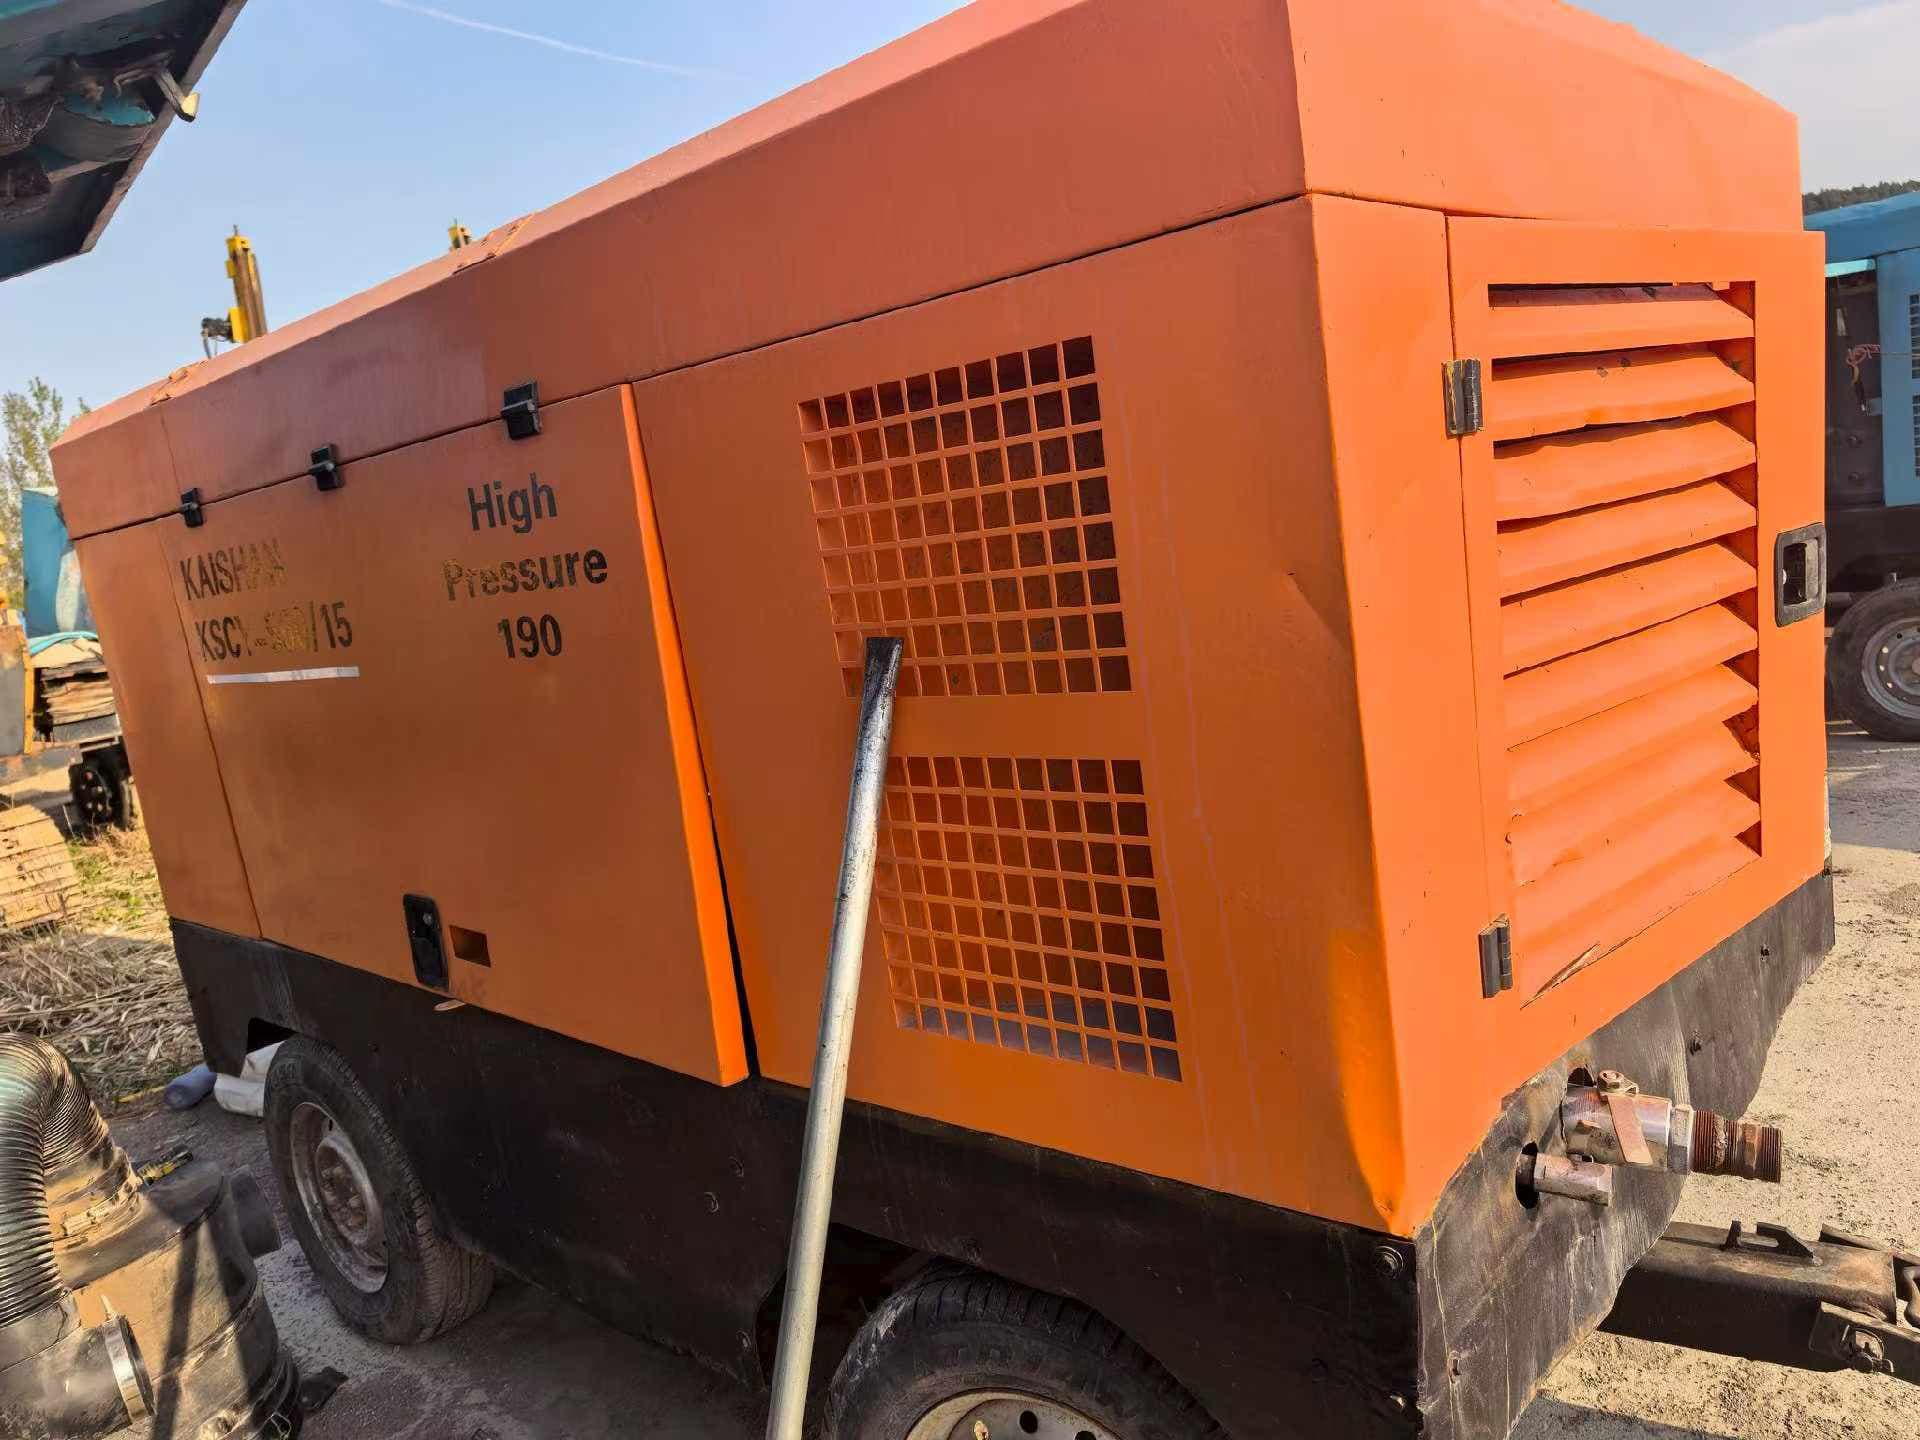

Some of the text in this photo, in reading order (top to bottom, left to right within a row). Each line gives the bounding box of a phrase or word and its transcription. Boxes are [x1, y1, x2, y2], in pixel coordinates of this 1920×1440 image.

[467, 472, 558, 533] High
[442, 549, 608, 601] Pressure
[498, 614, 562, 659] 190
